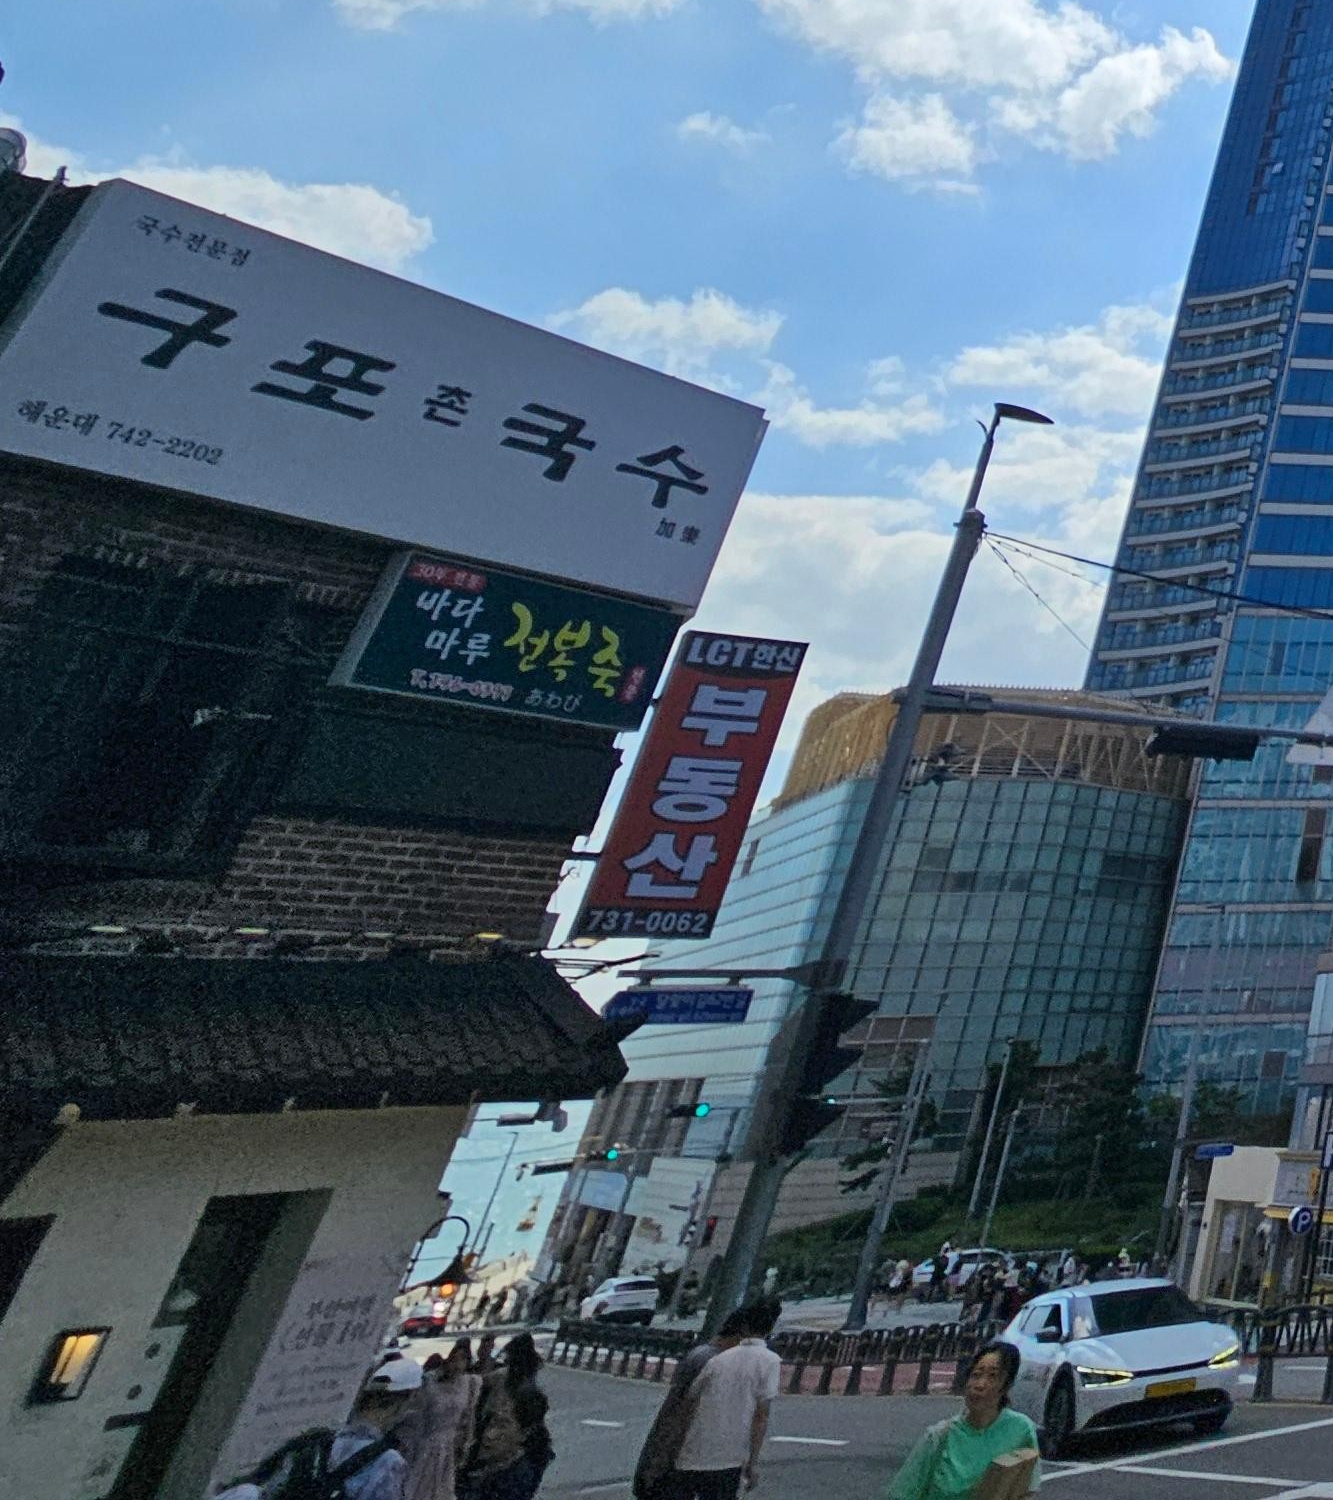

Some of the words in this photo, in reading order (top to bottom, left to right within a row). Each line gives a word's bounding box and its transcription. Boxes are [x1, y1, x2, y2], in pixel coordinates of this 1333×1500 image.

[136, 215, 251, 267] 국수전문점
[17, 399, 100, 436] 해운대
[106, 420, 223, 466] 742-2202
[416, 588, 485, 629] 바다
[424, 627, 492, 666] 마루
[503, 601, 623, 699] 전복죽
[686, 636, 800, 673] LCT한신
[623, 684, 768, 900] 부동산
[586, 910, 709, 934] 731-0062
